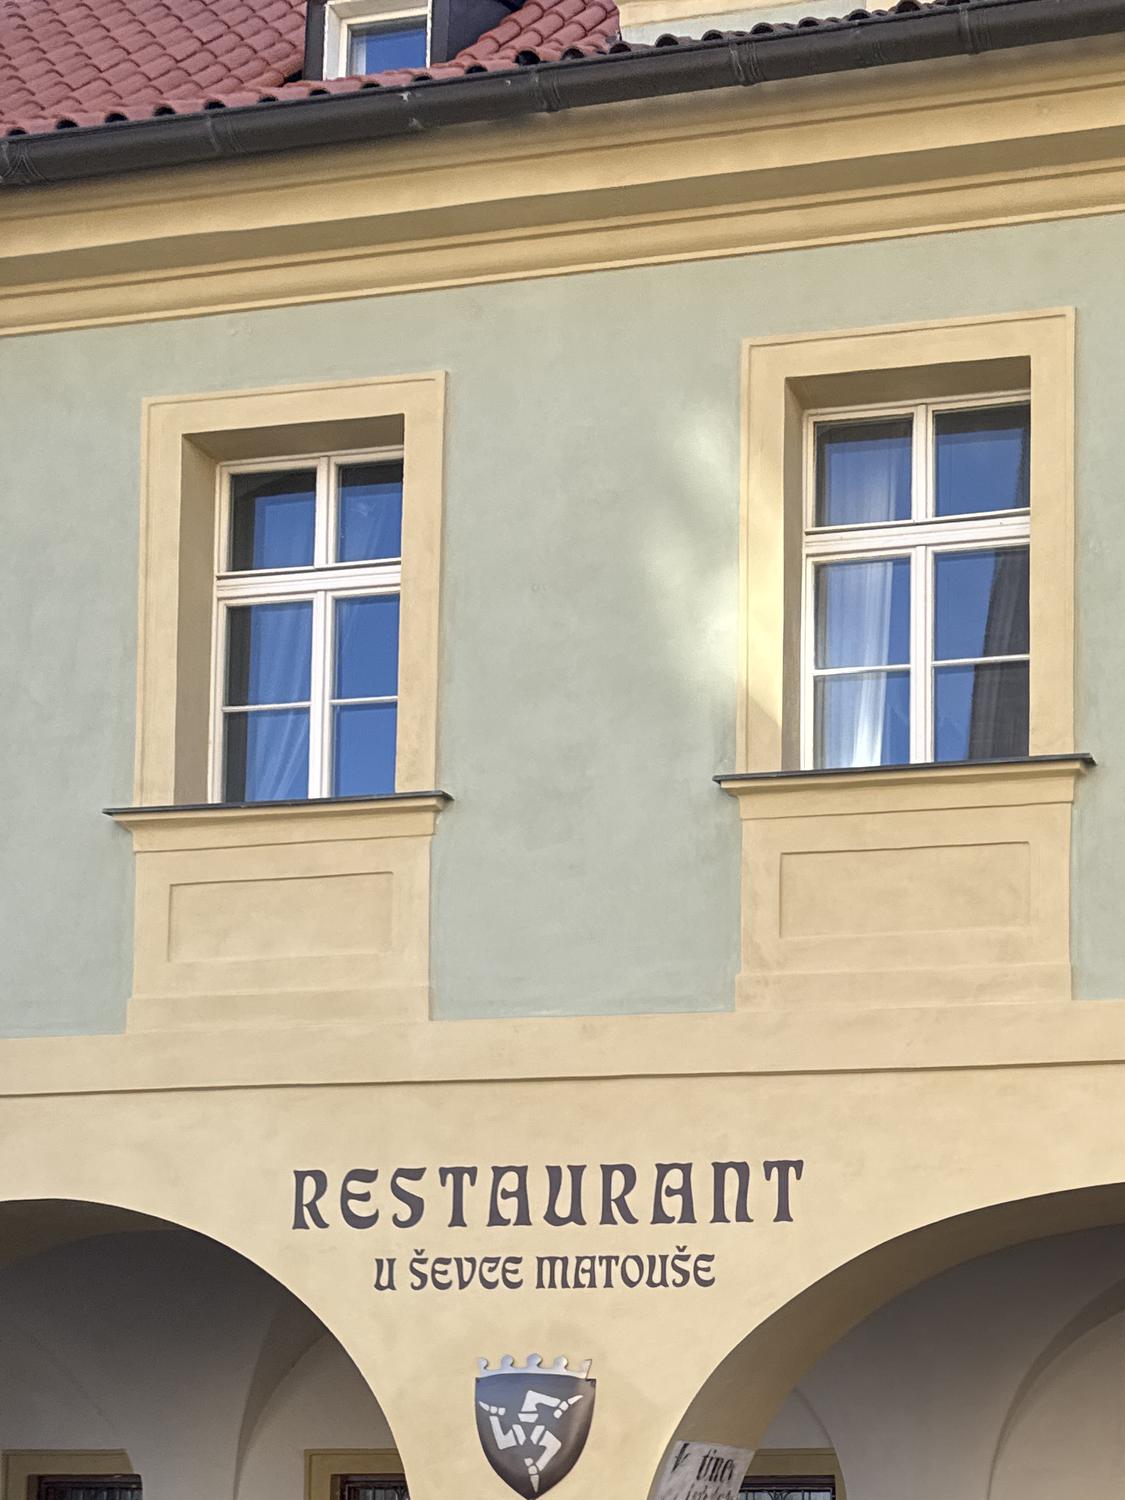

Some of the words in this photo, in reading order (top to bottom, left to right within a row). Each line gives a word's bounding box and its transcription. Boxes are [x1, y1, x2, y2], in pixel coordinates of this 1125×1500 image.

[291, 1159, 805, 1231] RESTAURANT
[373, 1257, 397, 1292] U
[409, 1248, 524, 1291] ŠEVCE
[535, 1244, 717, 1290] MATOUŠE
